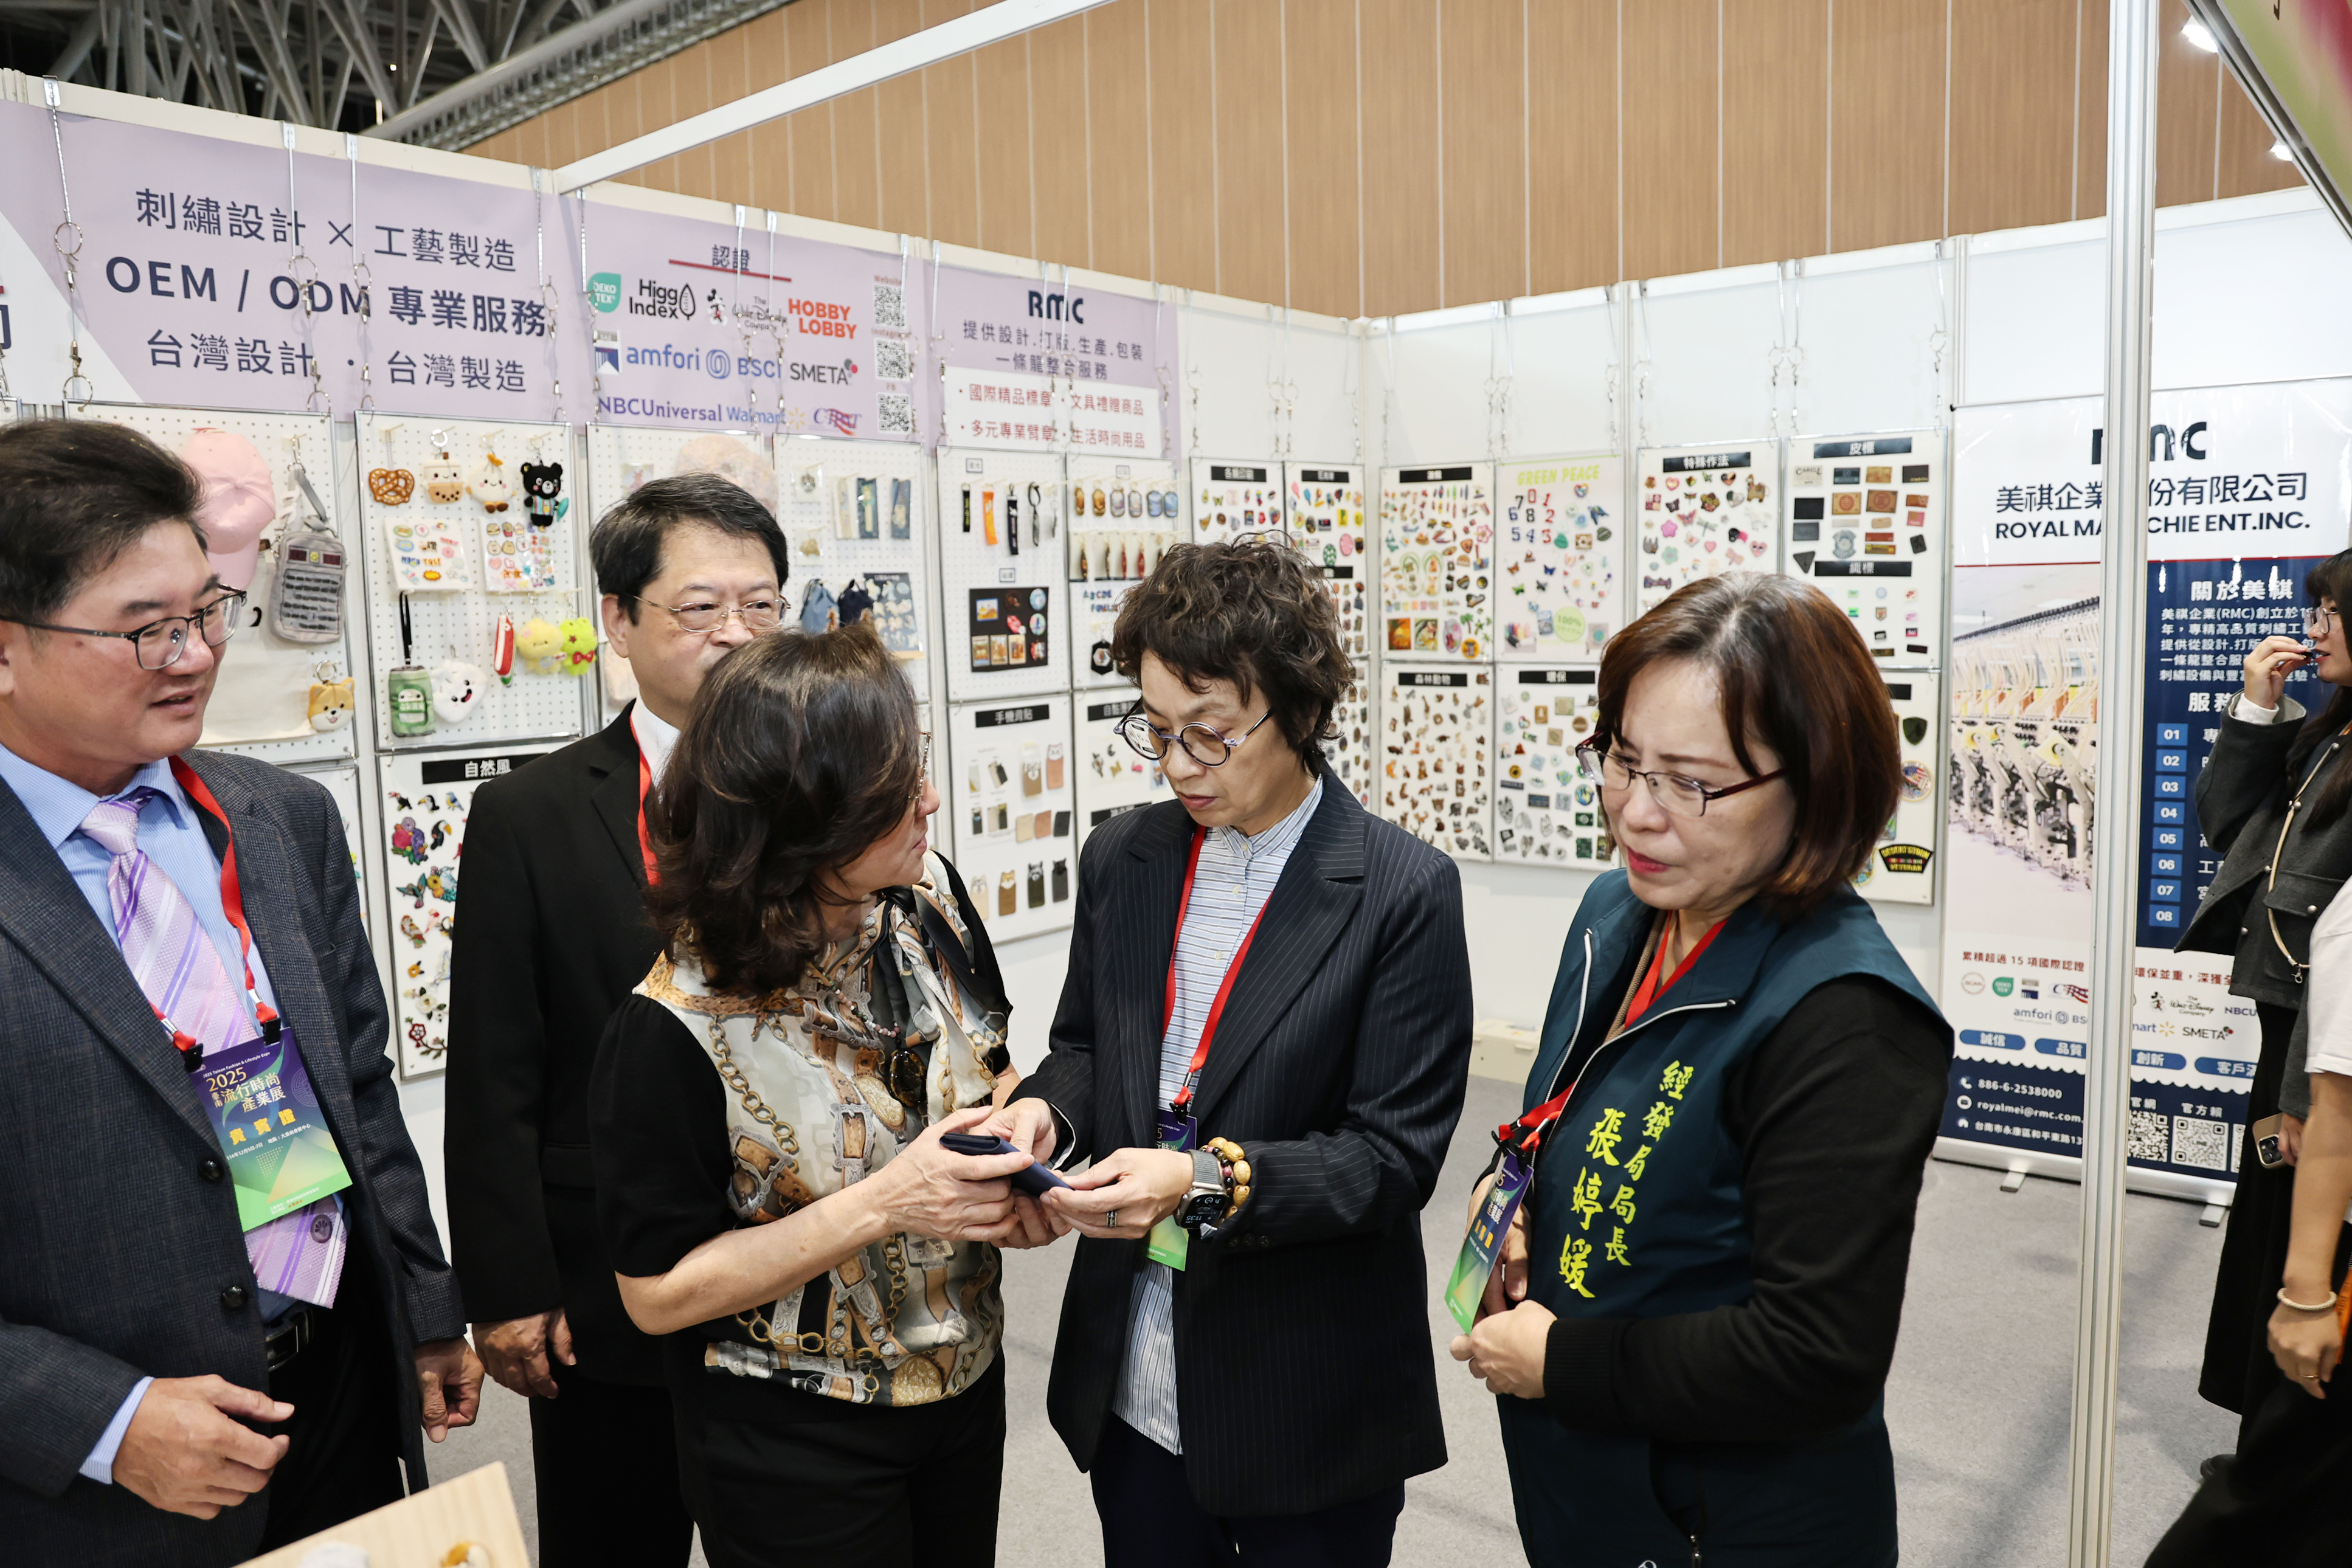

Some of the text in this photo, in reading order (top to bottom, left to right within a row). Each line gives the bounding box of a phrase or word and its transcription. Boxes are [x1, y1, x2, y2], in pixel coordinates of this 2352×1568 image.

[136, 188, 306, 245] 刺繡設計
[374, 224, 516, 272] 工藝製造
[711, 244, 750, 271] 認證
[106, 256, 217, 302] OEM
[270, 276, 370, 316] ODM
[389, 285, 546, 338] 專業服務
[639, 278, 678, 306] Higg
[629, 296, 679, 319] Index
[753, 296, 767, 305] The
[788, 298, 851, 322] HOBBY
[799, 317, 857, 339] LOBBY
[147, 329, 527, 393] 台灣設計 台灣製造
[626, 344, 781, 379] amfori BSCI
[790, 363, 849, 385] SMETA
[598, 396, 722, 422] NBCUniversal
[1849, 441, 1875, 456] 皮標
[1517, 465, 1600, 485] GREEN PEACE
[1527, 488, 1537, 503] 0
[1543, 492, 1550, 506] 1
[1996, 472, 2308, 514] 美祺企業份有限公司
[1515, 494, 1524, 509] 7
[1509, 506, 1518, 520] 6
[1526, 508, 1535, 522] 8
[1545, 509, 1554, 523] 2
[1512, 527, 1520, 541] 5
[1526, 528, 1535, 543] 4
[1541, 528, 1552, 544] 3
[1996, 521, 2068, 539] ROYAL
[2191, 579, 2294, 601] 關於美祺
[2164, 729, 2179, 740] 01
[464, 759, 512, 778] 自然風
[2163, 755, 2179, 767] 02
[2162, 781, 2179, 792] 03
[2160, 807, 2177, 818] 04
[2159, 834, 2176, 844] 05
[2158, 860, 2175, 870] 06
[2157, 885, 2174, 896] 07
[2156, 911, 2173, 922] 08
[2011, 956, 2024, 965] 15
[2013, 1008, 2088, 1024] amfori BS
[2225, 1006, 2258, 1017] NBCU
[2182, 1026, 2226, 1040] SMETA
[2056, 1042, 2083, 1057] 品質
[226, 1062, 241, 1071] Fashion
[244, 1054, 261, 1064] Lifestyle
[2136, 1051, 2165, 1066] 創新
[206, 1066, 247, 1092] 2025
[220, 1072, 281, 1104] 流行時尚
[1977, 1079, 2063, 1099] 886-6-2538000
[242, 1085, 286, 1113] 產業展
[1605, 1060, 1695, 1266] 經發局局長
[1558, 1107, 1627, 1298] 張婷媛
